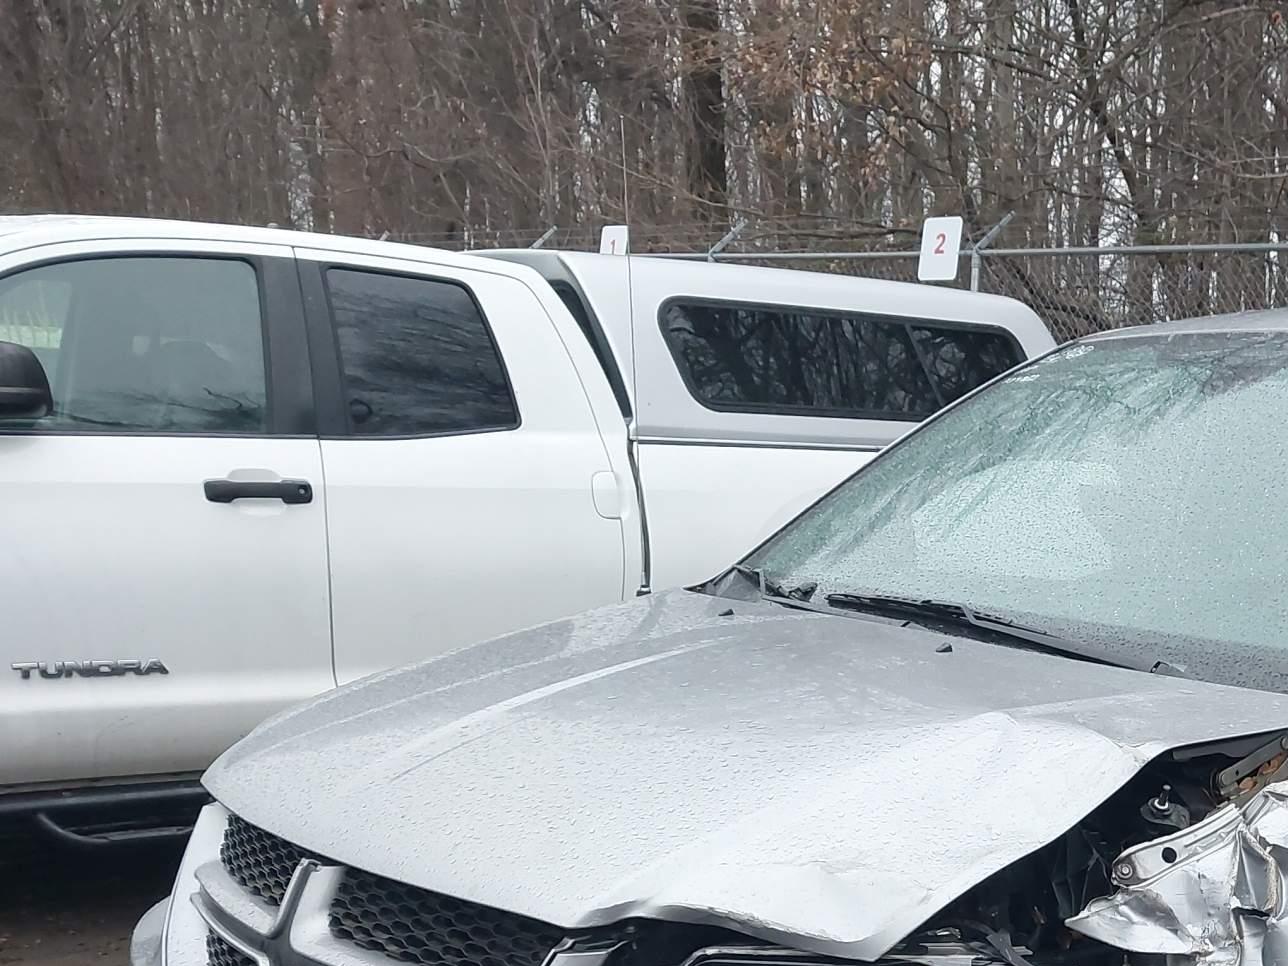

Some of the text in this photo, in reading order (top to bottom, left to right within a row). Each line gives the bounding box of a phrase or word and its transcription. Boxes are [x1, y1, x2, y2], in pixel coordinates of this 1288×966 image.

[610, 239, 616, 255] 1
[933, 232, 947, 255] 2
[11, 658, 170, 680] TUNDRA
